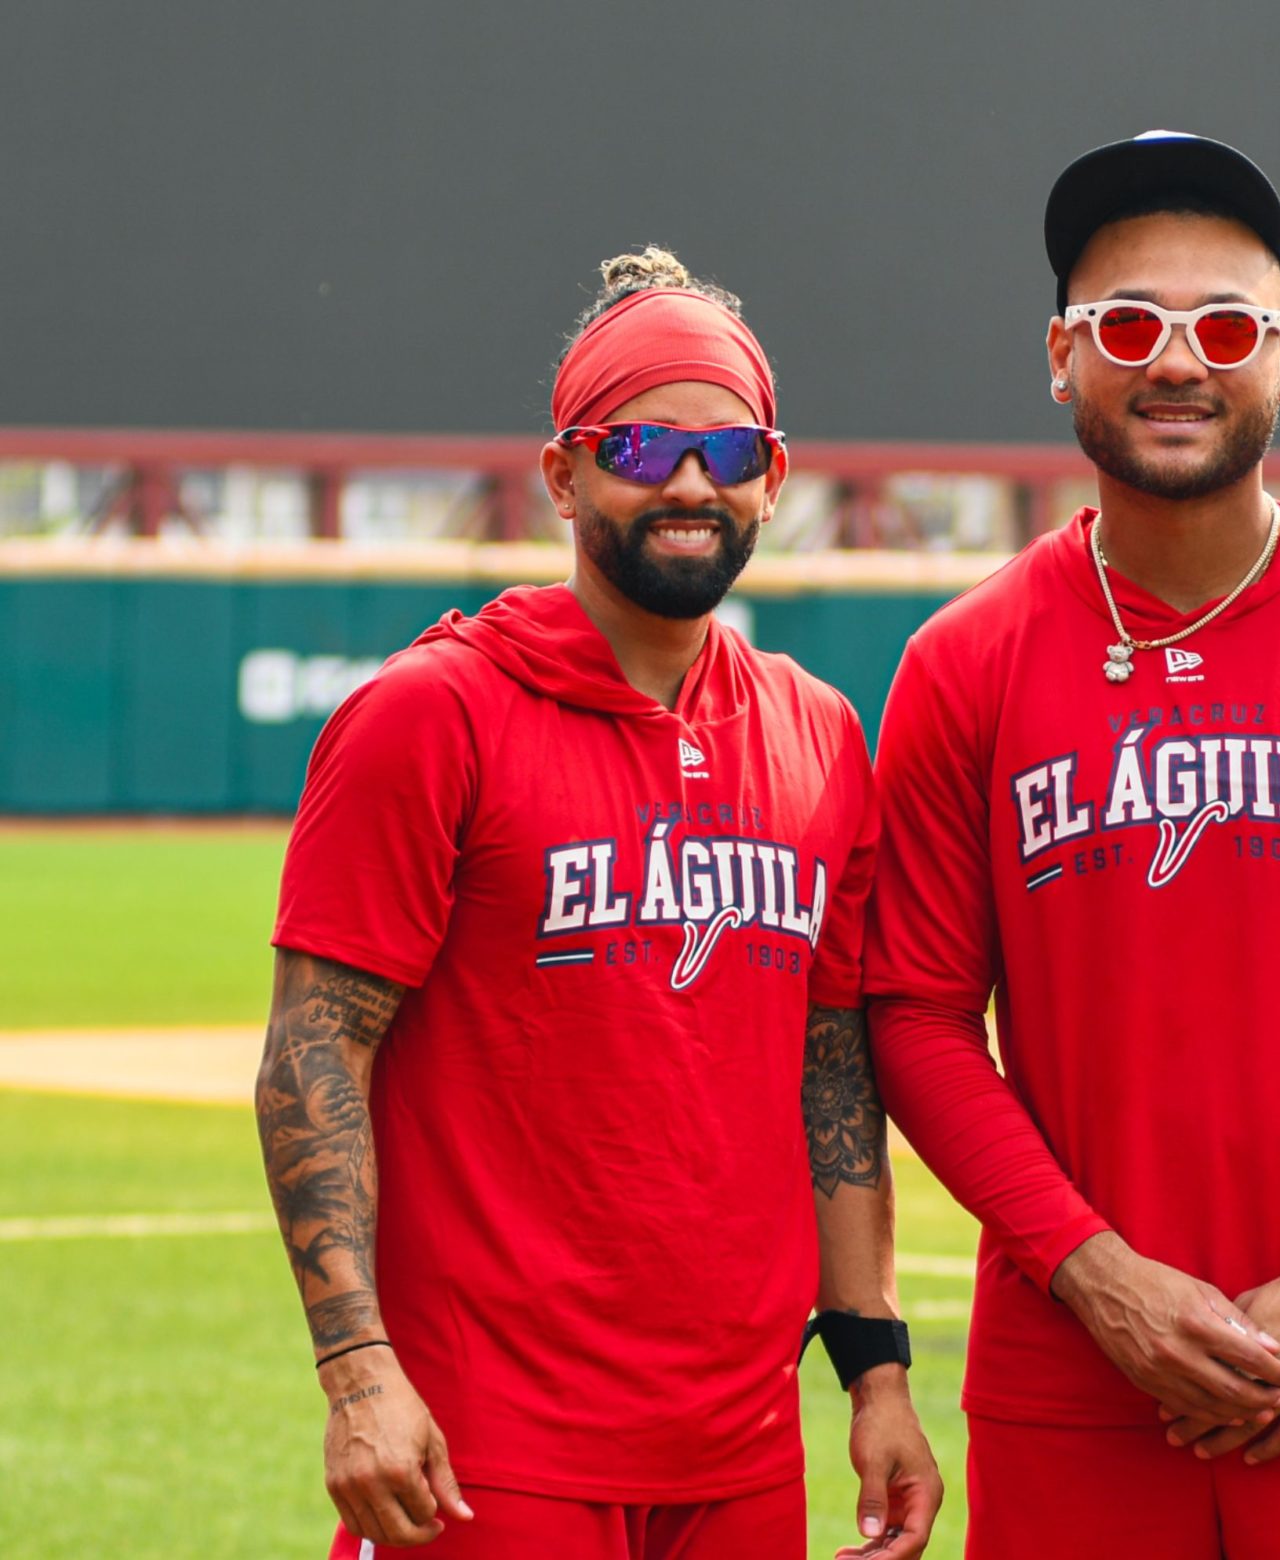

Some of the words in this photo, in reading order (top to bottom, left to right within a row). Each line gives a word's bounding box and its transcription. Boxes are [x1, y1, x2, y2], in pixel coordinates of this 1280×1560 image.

[1107, 703, 1269, 732] VERACRUZ
[1011, 751, 1095, 864] EL
[1074, 844, 1134, 875] EST.
[537, 838, 632, 940] EL
[606, 941, 660, 966] EST.
[747, 944, 800, 974] 1903
